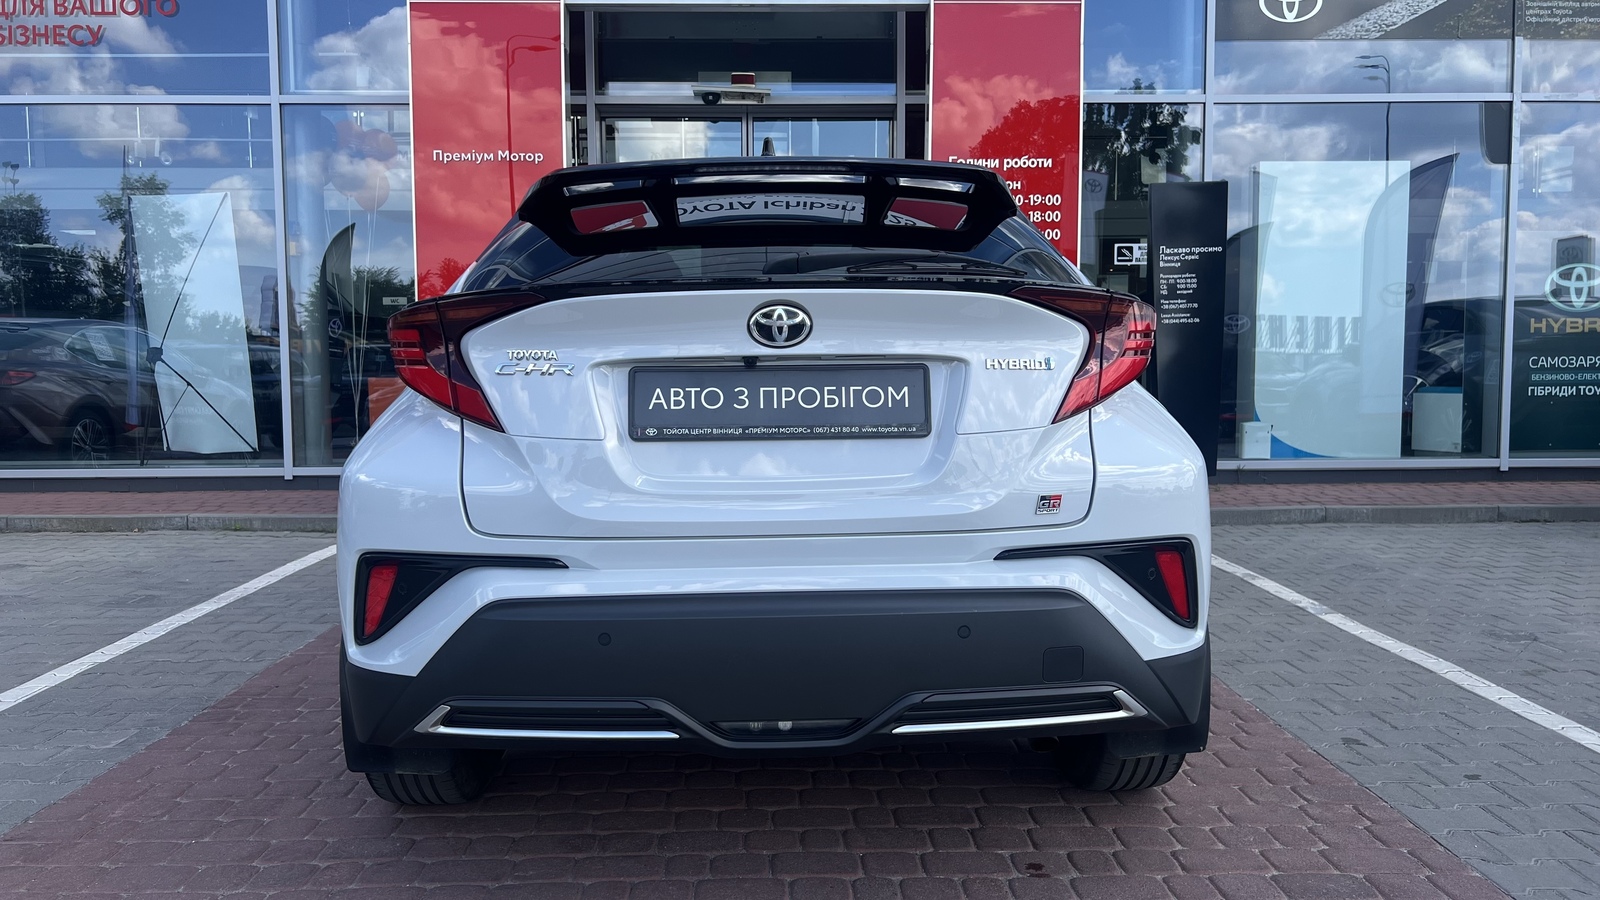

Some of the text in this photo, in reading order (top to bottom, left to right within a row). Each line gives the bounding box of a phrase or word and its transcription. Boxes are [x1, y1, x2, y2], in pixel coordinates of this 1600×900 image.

[433, 150, 544, 164] Преміум Мотор
[1004, 156, 1052, 171] роботи
[1012, 194, 1061, 206] 0-19:00
[1160, 245, 1223, 254] Ласкаво просимо
[1530, 317, 1600, 333] HYBR
[506, 349, 558, 361] TOYOTA
[494, 362, 575, 376] C-HR
[984, 358, 1045, 370] HYBRID
[1528, 386, 1577, 397] ГІБРИДИ
[649, 386, 909, 410] АВТО З ПРОБІГОМ
[663, 427, 690, 435] ТОЙОТА
[690, 428, 712, 436] ЦЕНТР
[713, 427, 743, 436] ВІННИЦЯ
[813, 426, 830, 434] (067)
[861, 426, 917, 434] www.toyota.vn.ua
[1040, 500, 1061, 508] GR
